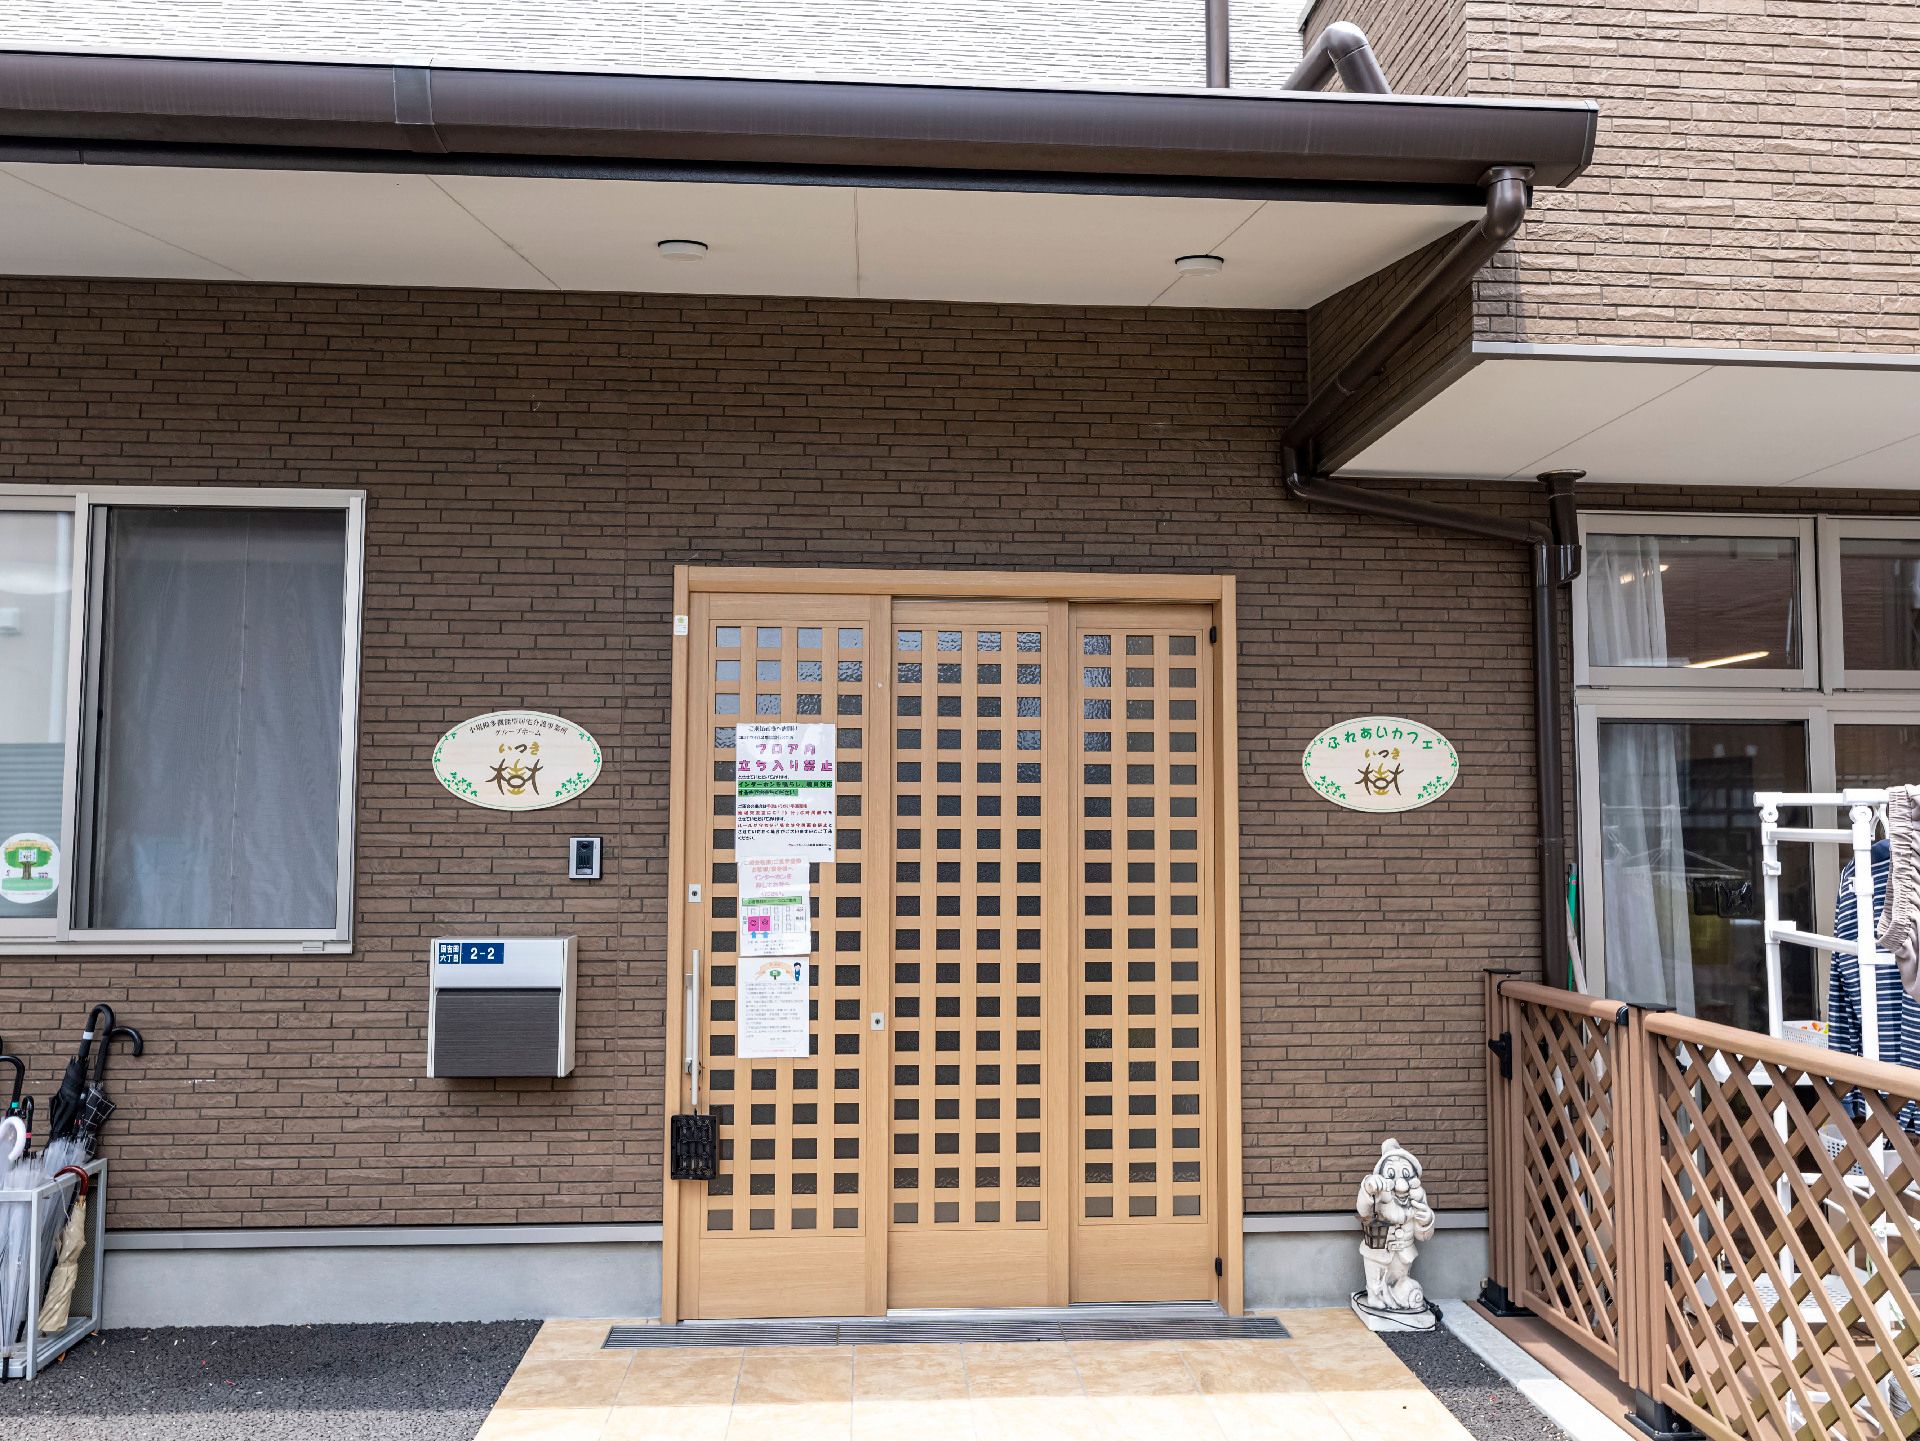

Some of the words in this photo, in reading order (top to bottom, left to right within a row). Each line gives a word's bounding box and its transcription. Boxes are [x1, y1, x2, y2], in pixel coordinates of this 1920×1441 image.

[495, 728, 541, 737] グループホーム
[1328, 725, 1433, 750] ふれあいカフェ
[498, 741, 541, 756] いつき
[1364, 747, 1400, 760] いつき
[737, 760, 833, 772] 立ち入り禁止
[439, 954, 459, 963] 六丁目
[470, 947, 495, 960] 2-2
